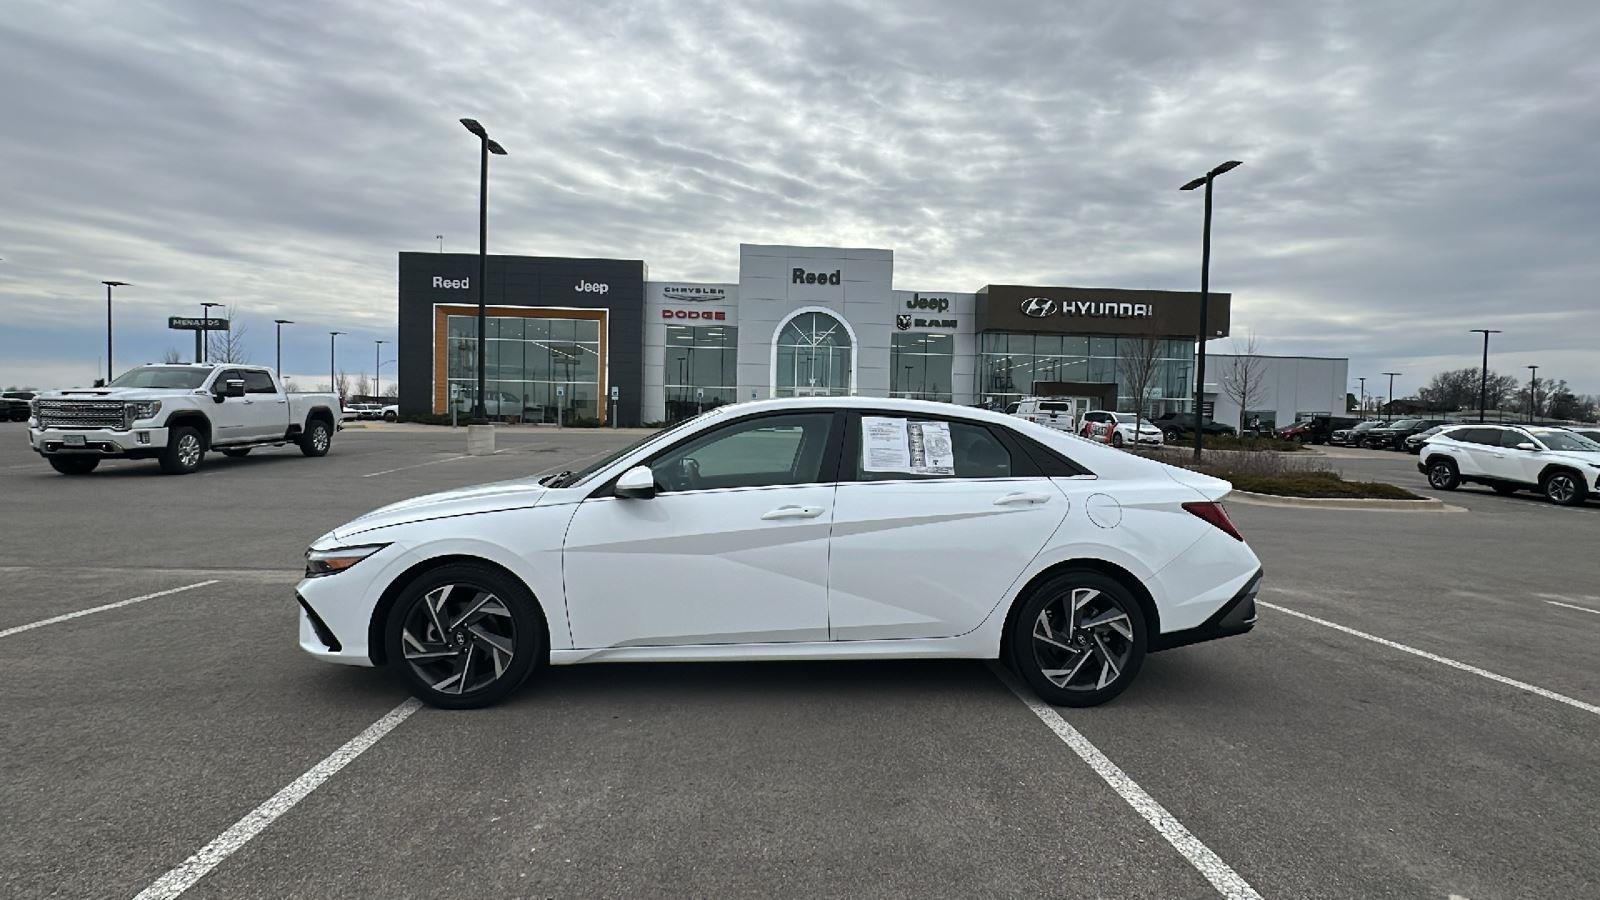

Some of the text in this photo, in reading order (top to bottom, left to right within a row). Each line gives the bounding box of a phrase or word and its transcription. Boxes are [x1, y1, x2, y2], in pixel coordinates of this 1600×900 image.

[432, 276, 469, 289] Reed
[792, 267, 841, 286] Reed
[574, 279, 609, 295] Jeep
[906, 292, 949, 313] Jeep
[1062, 301, 1153, 316] HYUNDAI
[662, 309, 726, 321] DODGE
[914, 318, 958, 329] RAM
